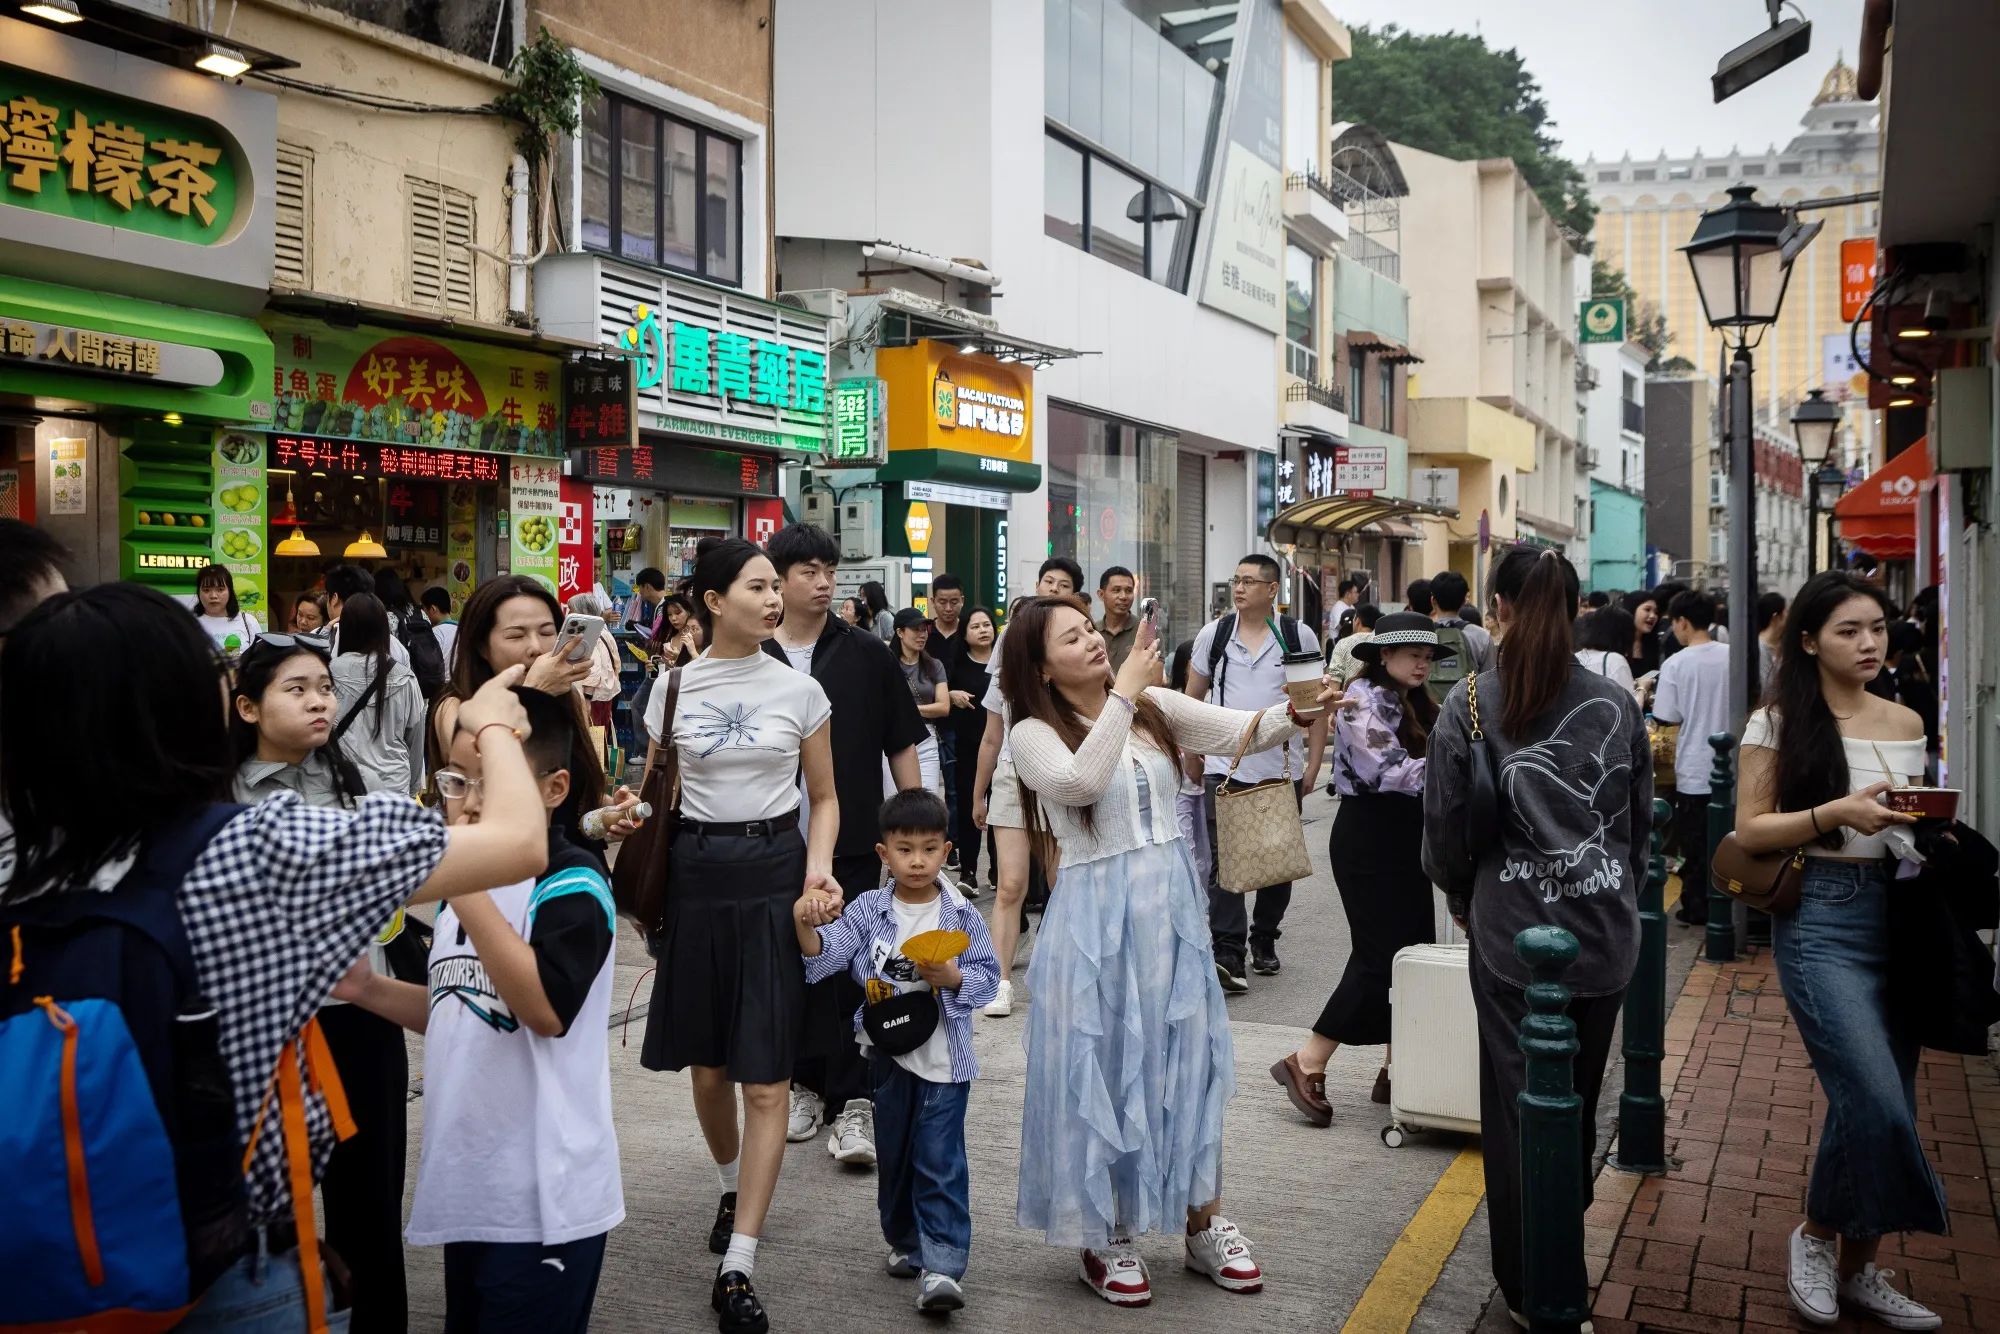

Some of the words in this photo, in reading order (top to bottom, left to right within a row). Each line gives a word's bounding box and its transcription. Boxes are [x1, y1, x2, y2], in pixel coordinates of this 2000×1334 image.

[44, 327, 161, 375] 人間清醒
[672, 321, 825, 414] 萬青藥房
[362, 352, 474, 409] 好美味
[508, 366, 550, 393] 正宗
[573, 374, 623, 395] 好美味
[656, 415, 716, 436] FARMACIA
[720, 424, 783, 446] EVERGREEN
[837, 388, 868, 457] 藥房
[387, 524, 440, 544] 咖喱魚旦
[140, 554, 184, 568] LEMON
[997, 520, 1008, 602] Lemon
[1539, 858, 1624, 903] Dwarfs
[882, 1014, 911, 1030] GAME
